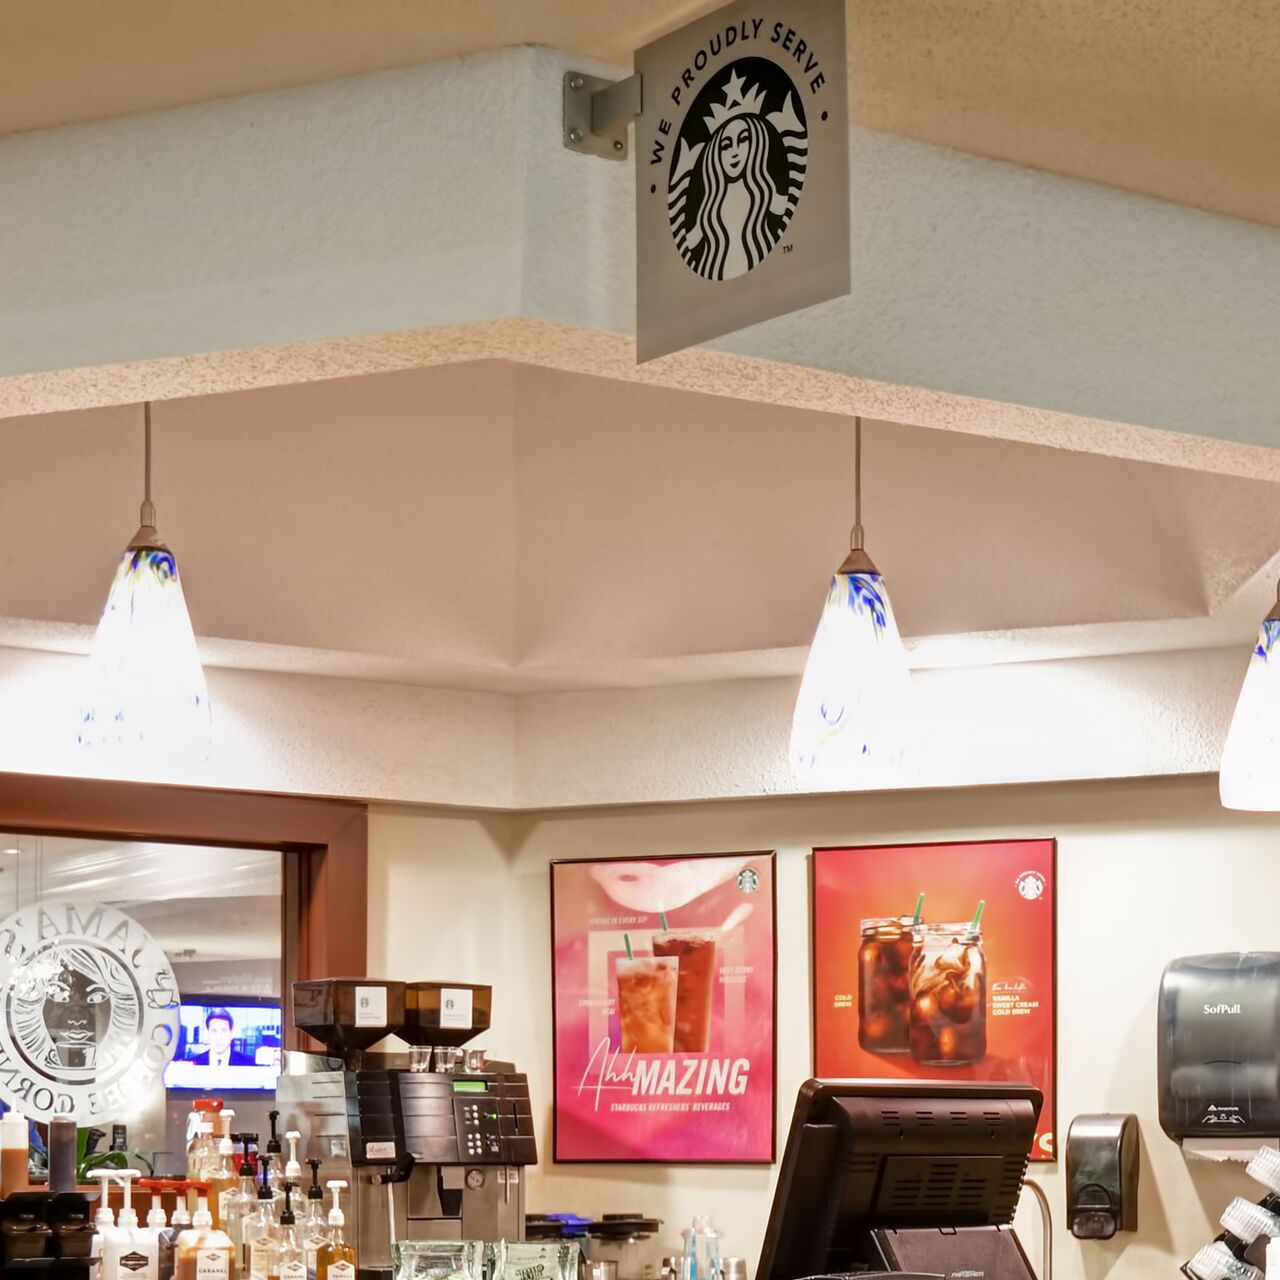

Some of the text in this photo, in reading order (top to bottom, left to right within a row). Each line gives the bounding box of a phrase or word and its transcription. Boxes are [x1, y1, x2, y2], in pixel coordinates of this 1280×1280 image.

[650, 18, 826, 166] WE PROUDLY SERVE
[992, 994, 1020, 1002] VANILLA
[992, 1000, 1039, 1009] SWEET CREAM
[1203, 1003, 1241, 1015] SofPull
[992, 1008, 1010, 1016] COLD
[609, 1102, 647, 1112] STARBUCKS
[691, 1101, 731, 1111] BEVERAGES
